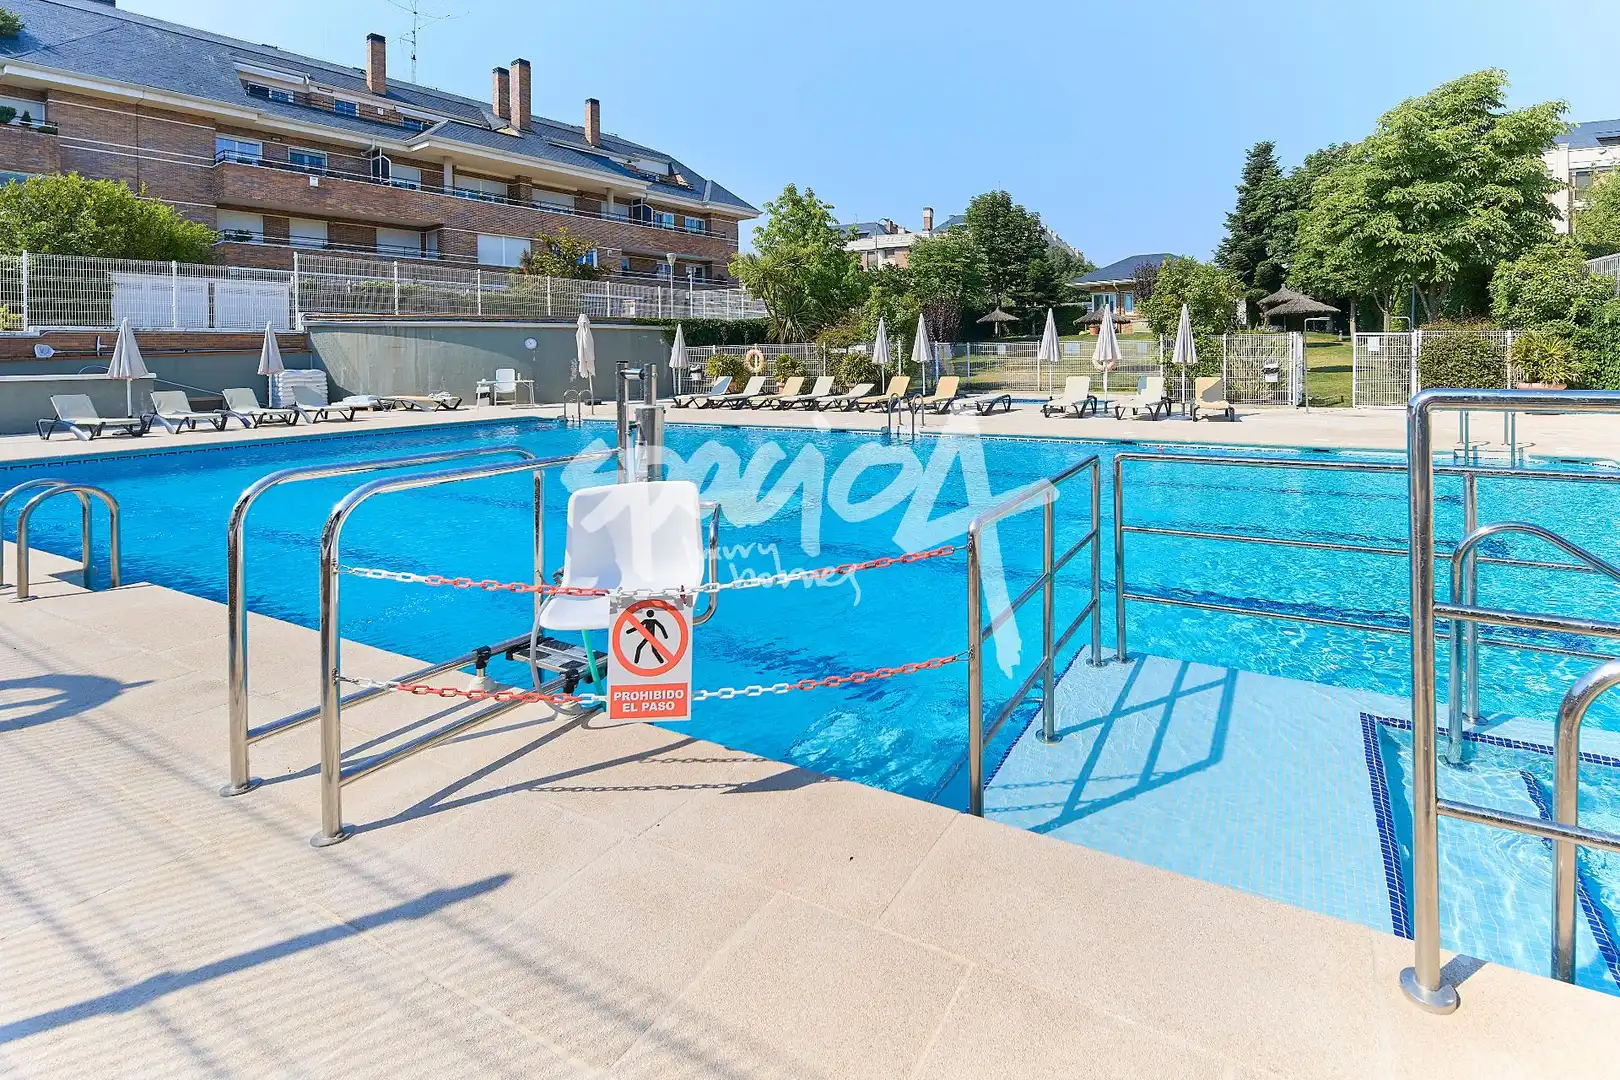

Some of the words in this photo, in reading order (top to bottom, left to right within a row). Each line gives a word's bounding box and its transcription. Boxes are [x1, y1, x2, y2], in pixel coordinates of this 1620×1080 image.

[613, 689, 684, 702] PROHIBIDO
[622, 702, 638, 713] EL
[641, 701, 676, 712] PASO
